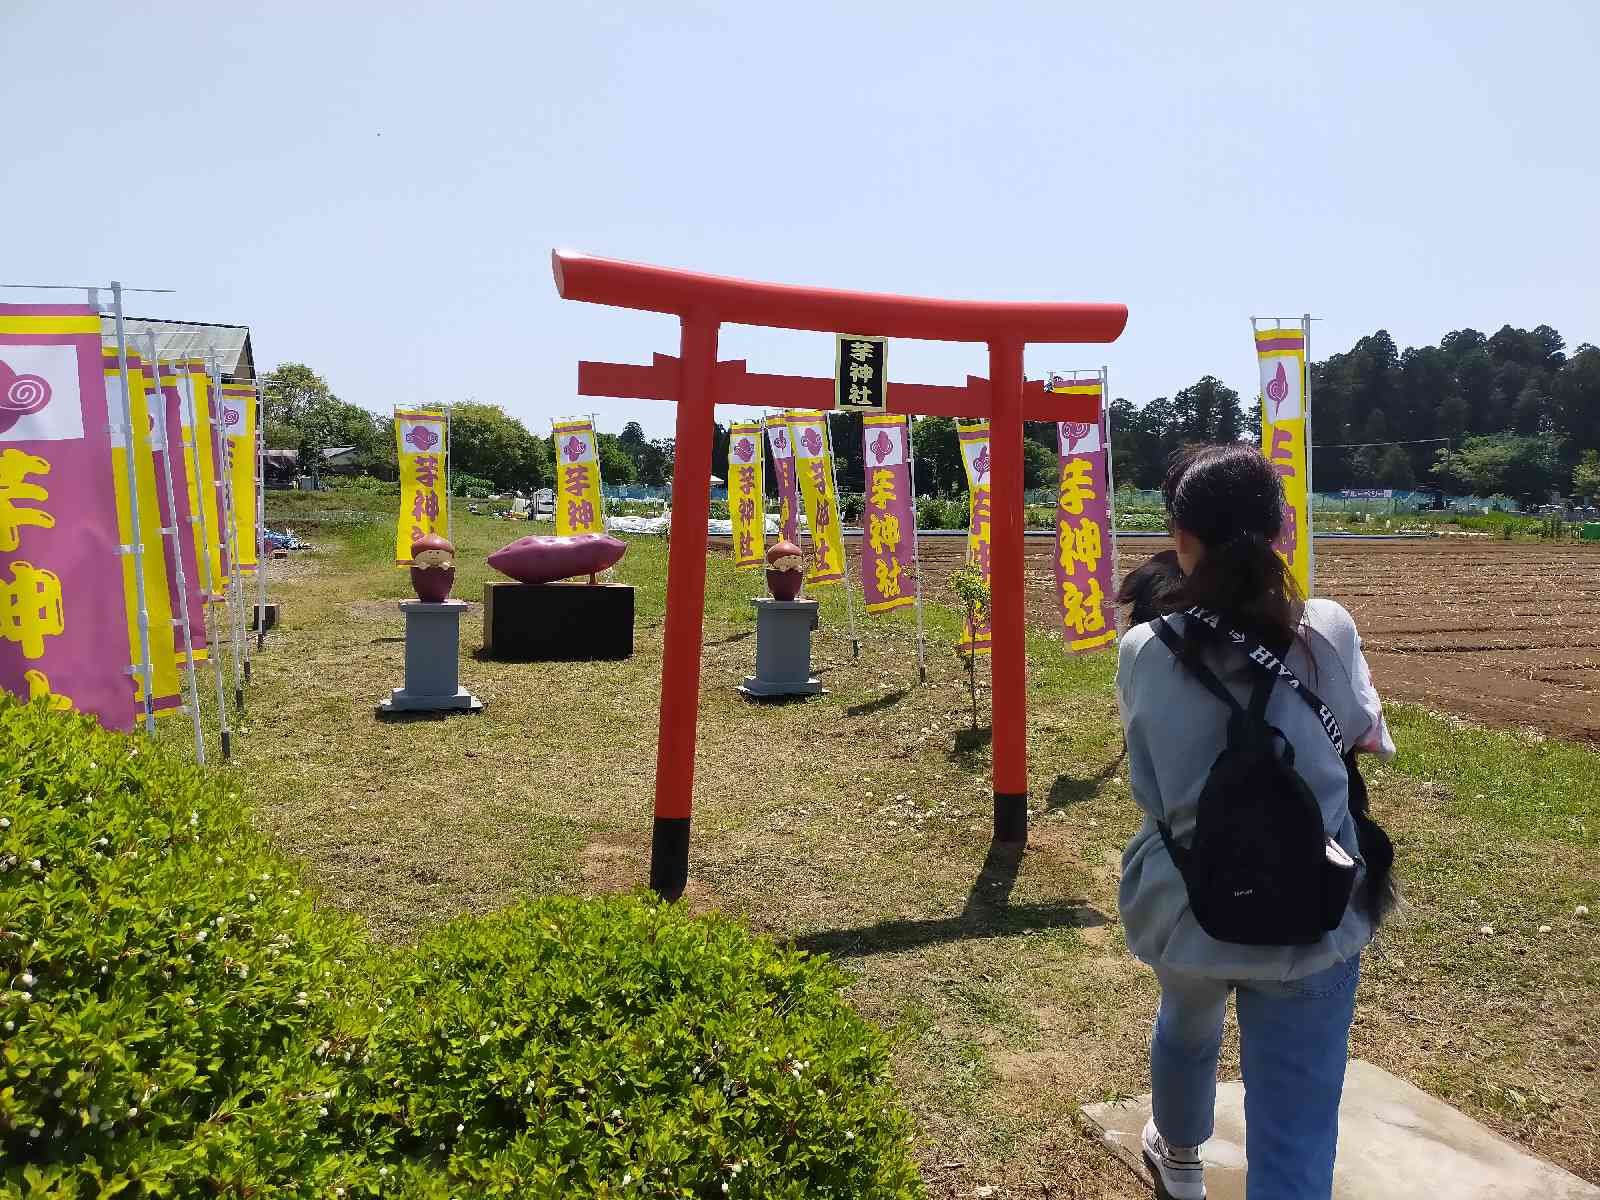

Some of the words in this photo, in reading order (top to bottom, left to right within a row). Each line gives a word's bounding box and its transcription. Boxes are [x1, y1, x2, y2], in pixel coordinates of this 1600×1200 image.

[849, 341, 874, 404] 芋神社
[870, 469, 902, 598] 芋神社
[1059, 458, 1106, 634] 芋神社
